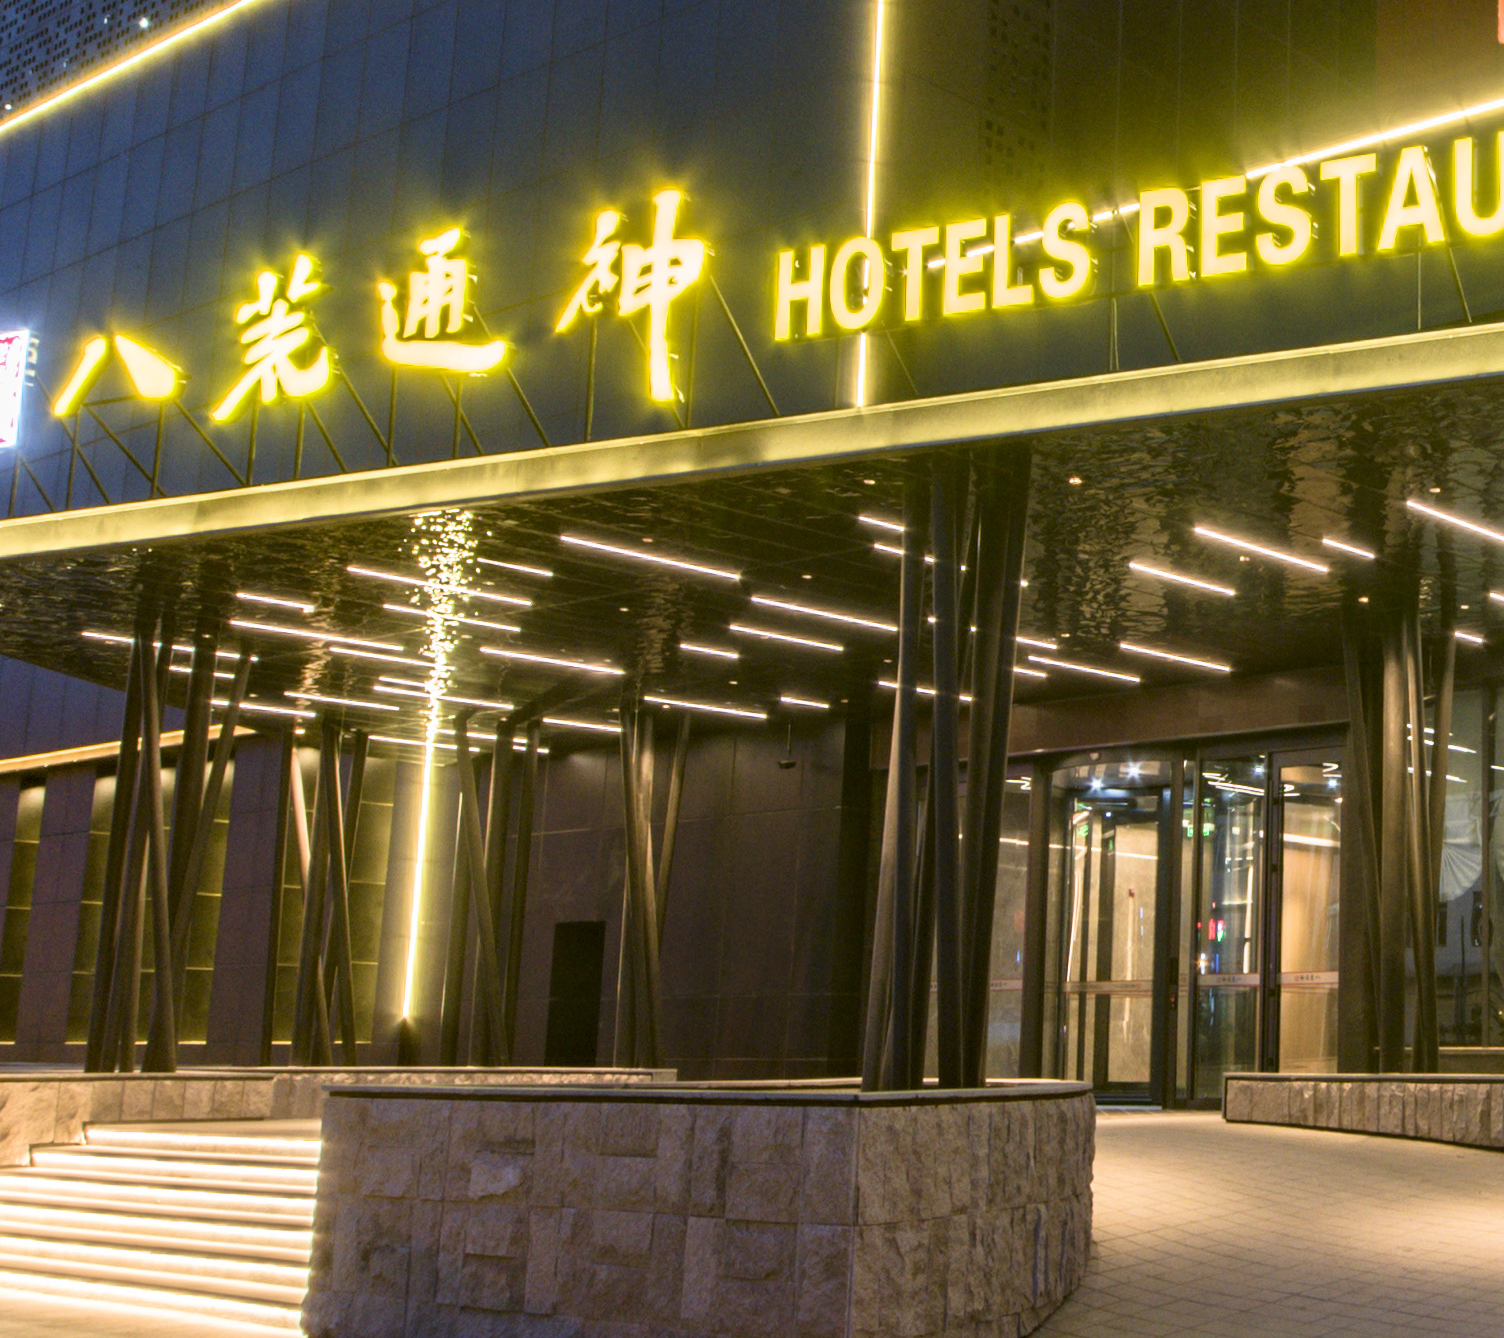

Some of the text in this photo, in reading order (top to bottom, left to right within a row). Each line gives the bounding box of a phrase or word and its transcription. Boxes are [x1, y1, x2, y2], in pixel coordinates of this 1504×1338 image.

[53, 187, 709, 423] 八荒通神
[773, 198, 1094, 343] HOTELS
